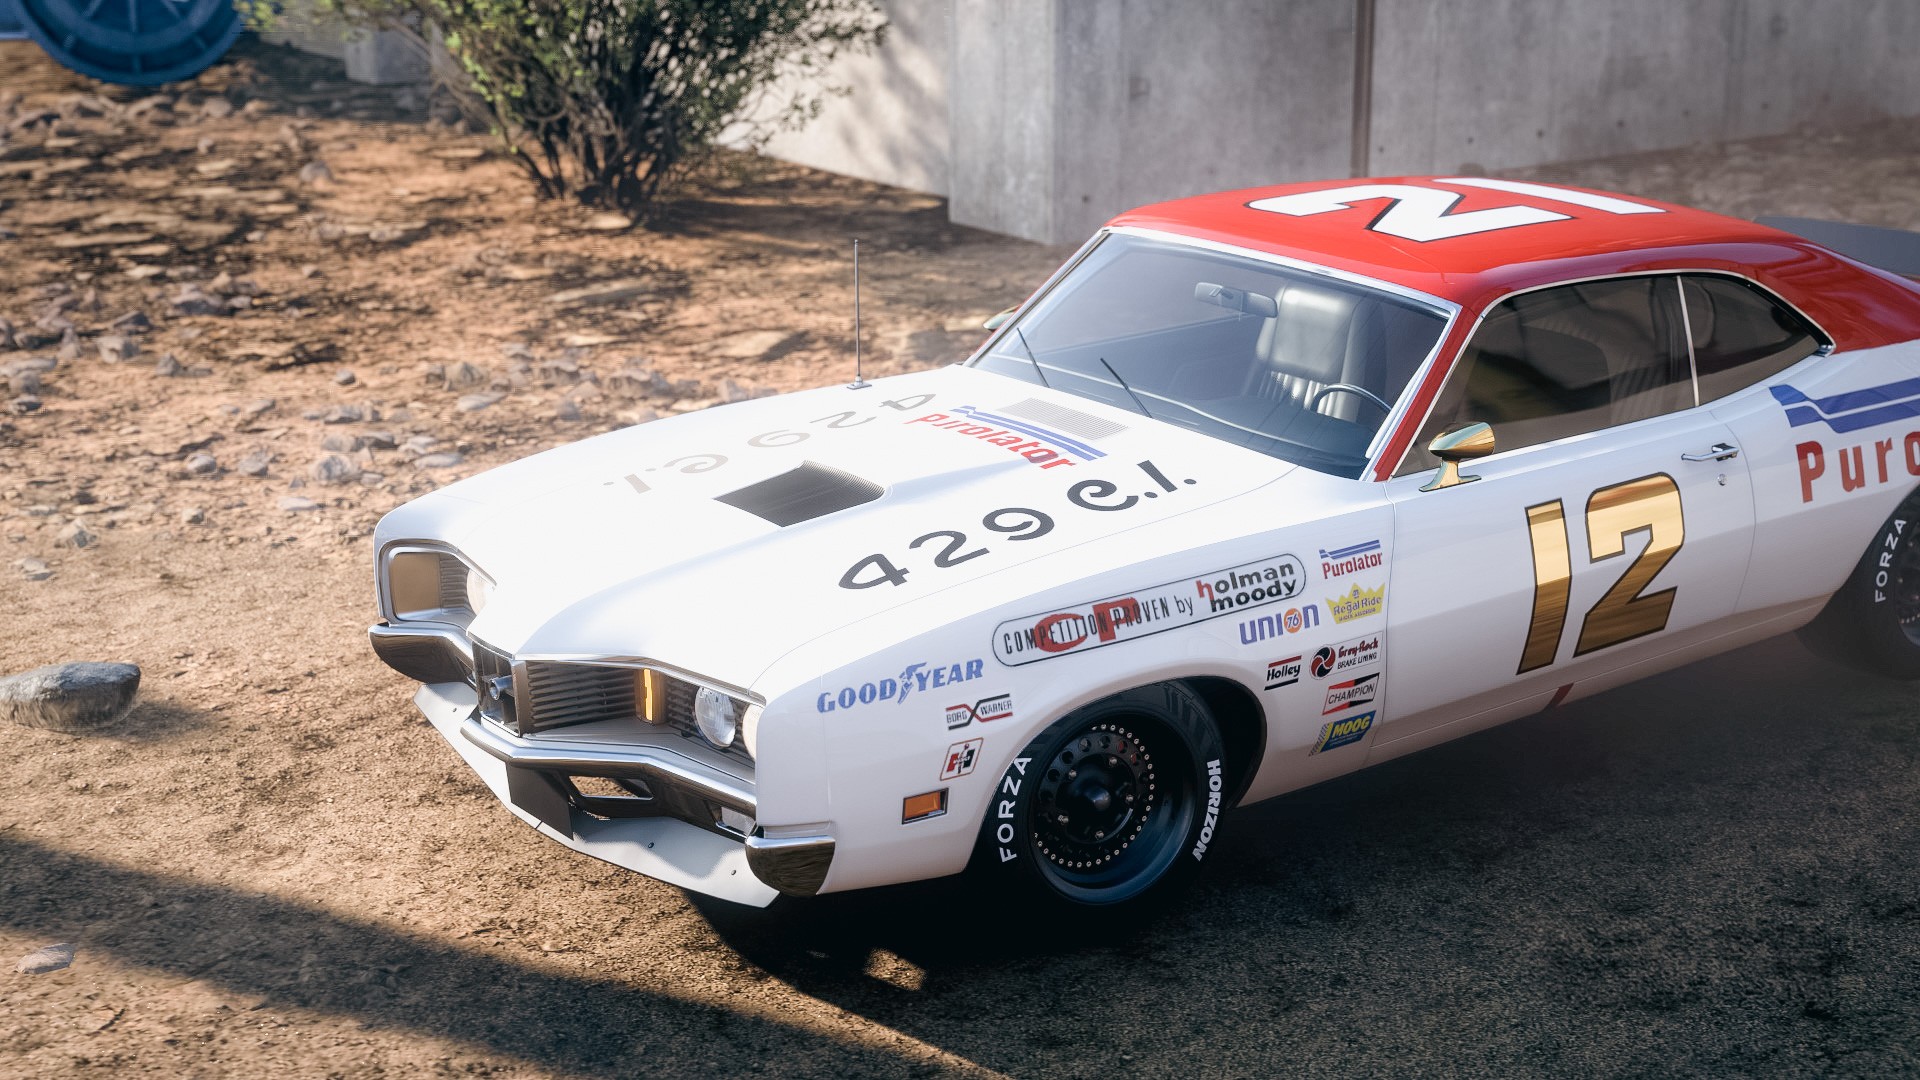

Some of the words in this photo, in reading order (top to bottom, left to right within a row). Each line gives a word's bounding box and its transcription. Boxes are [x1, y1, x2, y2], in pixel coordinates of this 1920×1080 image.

[747, 393, 937, 448] 429
[1795, 431, 1920, 504] Puro
[837, 507, 1055, 590] 429
[1322, 552, 1383, 579] Purolator
[1874, 519, 1907, 603] FORZA
[1195, 562, 1295, 602] holman
[1516, 471, 1686, 675] 12
[1211, 577, 1297, 613] moody
[1333, 600, 1360, 616] Regal
[1361, 597, 1382, 609] Ride
[1003, 609, 1108, 655] COMPETITION
[1113, 596, 1170, 630] PROVEN
[1174, 595, 1194, 616] by
[1286, 613, 1300, 629] 76
[1266, 664, 1301, 682] Holley
[1337, 657, 1357, 670] BRAKE
[1358, 652, 1377, 664] LINING
[946, 710, 967, 724] BORG
[980, 699, 1013, 716] WARNER
[1328, 683, 1376, 704] CHAMPION
[1332, 715, 1371, 738] MOOG
[997, 756, 1032, 863] FORZA
[1192, 758, 1222, 862] HORIZON
